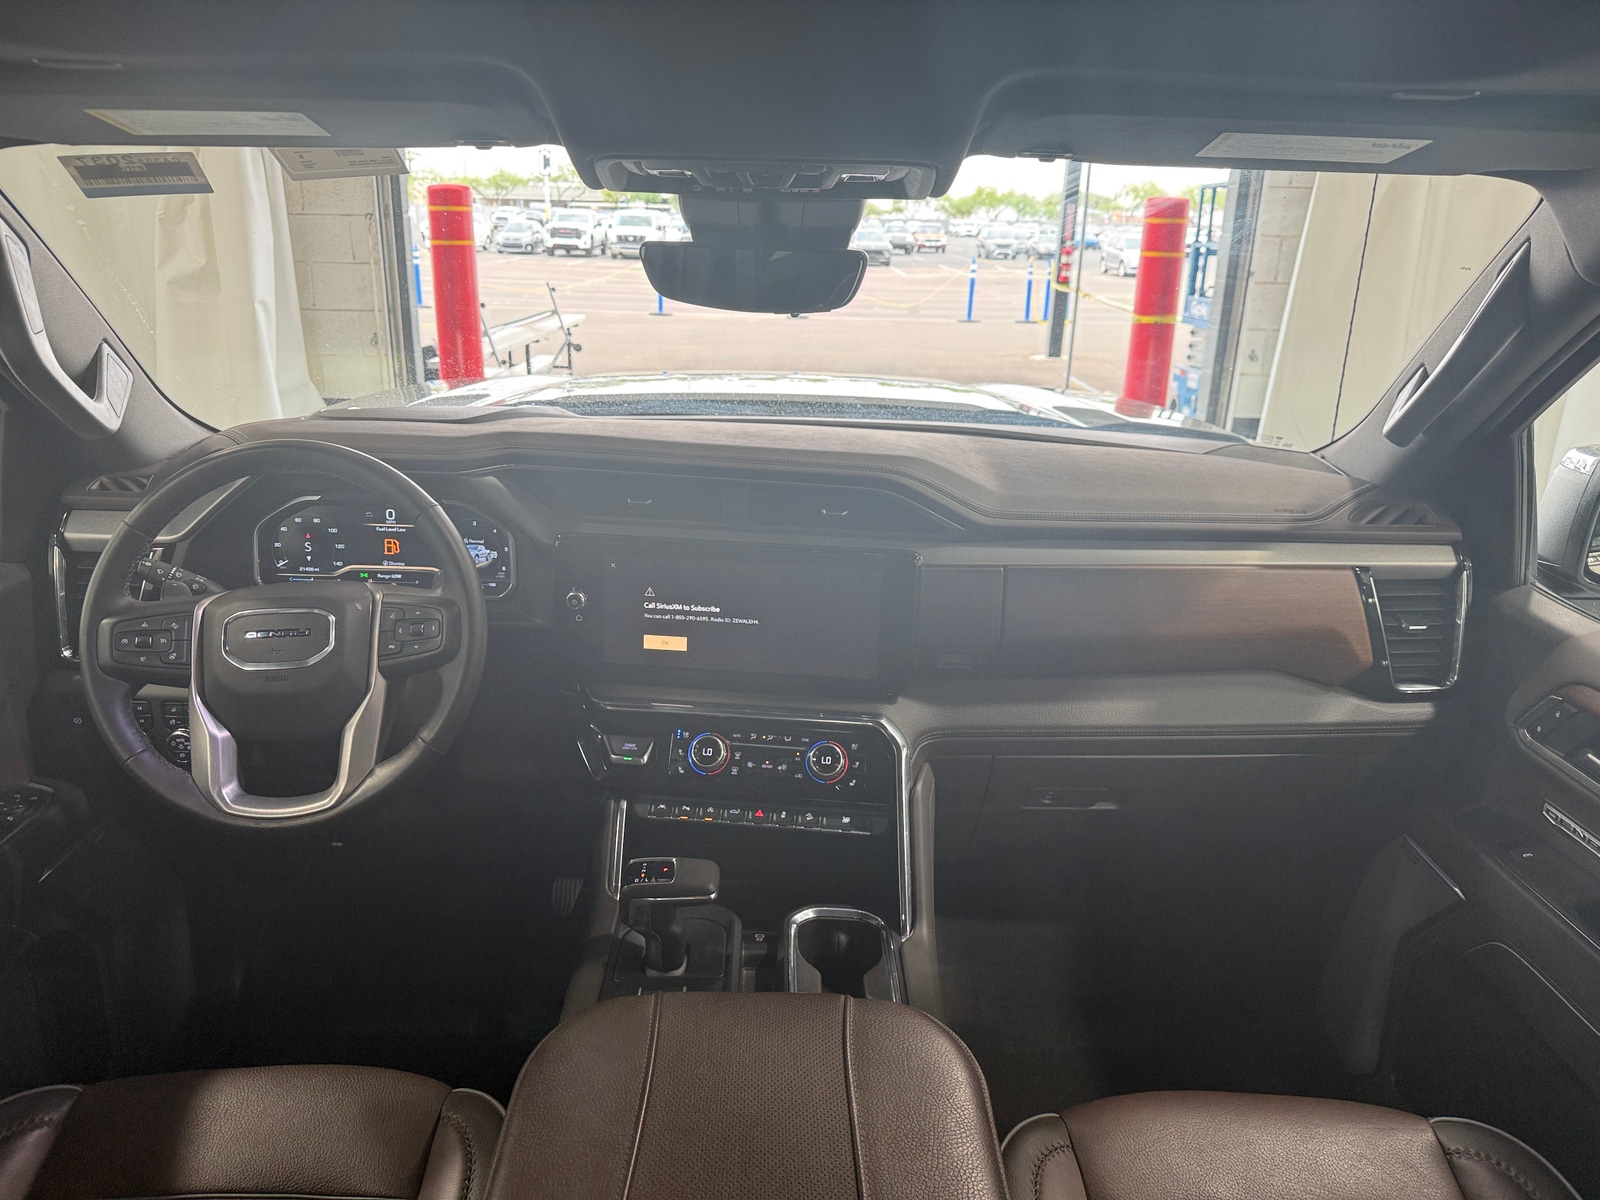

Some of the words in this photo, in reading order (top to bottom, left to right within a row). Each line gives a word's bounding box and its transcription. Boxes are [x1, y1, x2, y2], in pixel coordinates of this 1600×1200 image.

[385, 508, 396, 520] 0
[691, 605, 721, 613] Subscribe
[244, 628, 311, 639] DENALI
[702, 747, 713, 756] LO
[821, 756, 832, 765] LO
